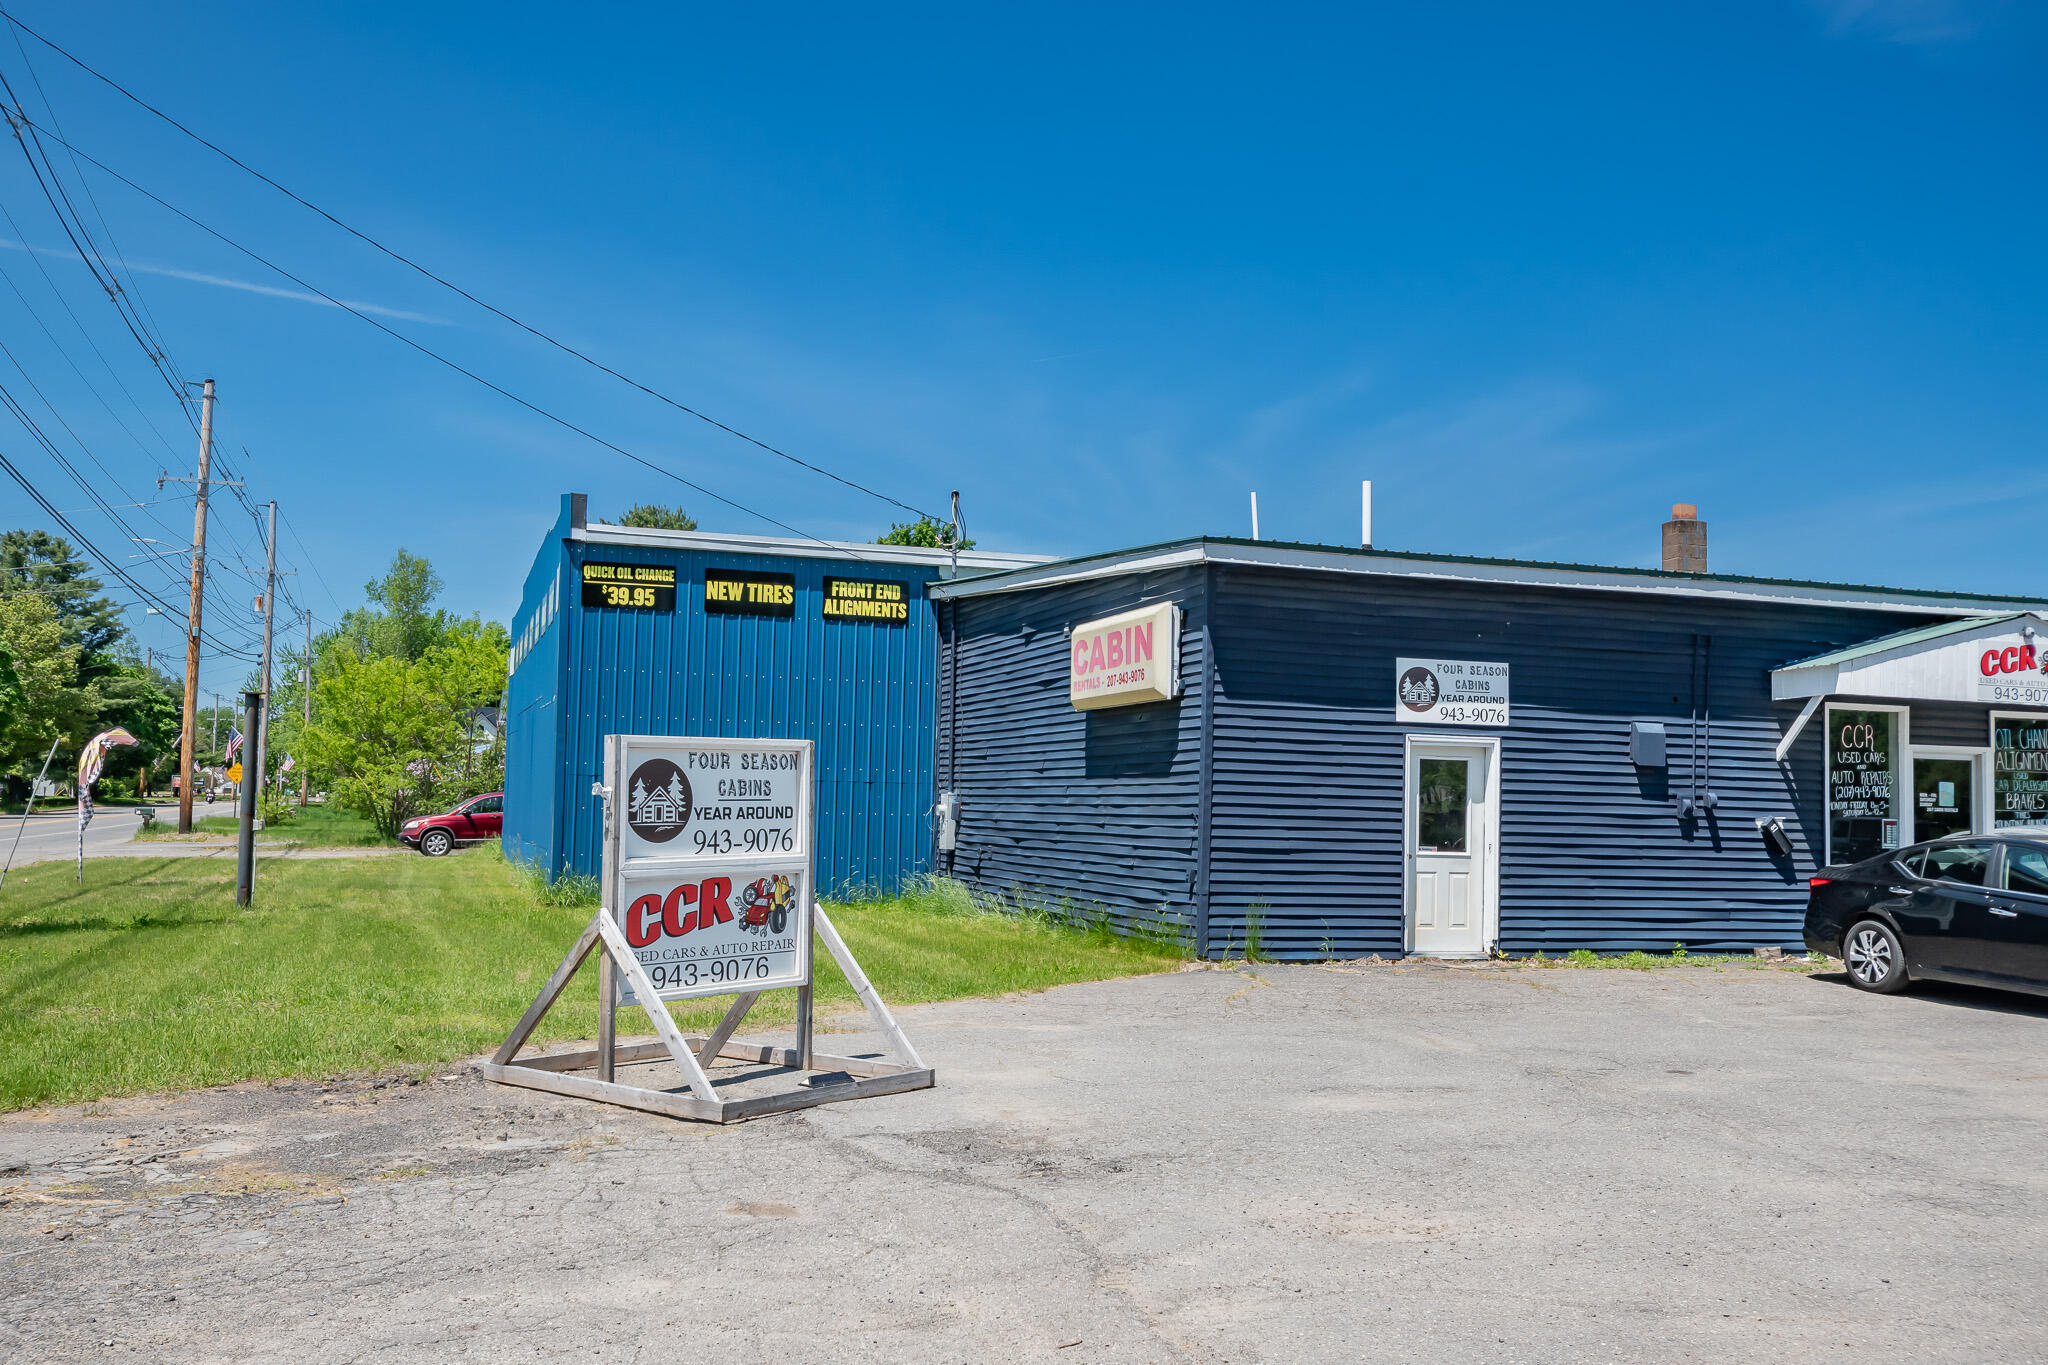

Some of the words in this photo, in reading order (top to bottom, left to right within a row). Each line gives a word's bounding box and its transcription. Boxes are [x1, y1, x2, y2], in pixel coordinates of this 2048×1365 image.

[583, 565, 616, 579] QUICK
[617, 567, 634, 579] OIL
[635, 568, 675, 582] CHANGE
[602, 585, 655, 607] $39.95
[706, 581, 744, 602] NEW
[746, 583, 794, 605] TIRES
[832, 581, 874, 599] FRONT
[876, 584, 901, 601] END
[823, 598, 907, 619] ALIGNMENTS
[1073, 621, 1153, 676] CABIN
[1436, 664, 1463, 675] FOUR
[1469, 665, 1508, 677] SEASON
[1980, 644, 2038, 677] CCR
[1073, 677, 1101, 692] RENTALS
[1107, 668, 1145, 688] 207-943-9076
[1455, 680, 1490, 691] CABINS
[1440, 694, 1465, 703] YEAR
[1467, 695, 1505, 704] AROUND
[1994, 686, 2048, 702] 943-907
[1440, 706, 1505, 723] 943-9076
[1841, 724, 1874, 751] CCR
[1995, 728, 2015, 750] OIL
[688, 751, 731, 770] FOUR
[741, 751, 798, 771] SEASON
[1837, 751, 1861, 764] USED
[1863, 752, 1886, 765] CARS
[1996, 751, 2048, 771] ALIGNMEN
[718, 778, 772, 797] CABINS
[1831, 770, 1855, 784] AUTO
[1860, 770, 1894, 786] REPAIRS
[2006, 792, 2046, 810] BRAKES
[693, 806, 732, 821] YEAR
[736, 805, 794, 820] AROUND
[693, 827, 793, 855] 943-9076
[626, 876, 735, 949] CCR
[634, 951, 660, 963] SED
[662, 946, 697, 961] CARS
[699, 946, 709, 957] &
[712, 942, 748, 956] AUTO
[751, 938, 795, 951] REPAIR
[651, 955, 769, 990] 943-9076
